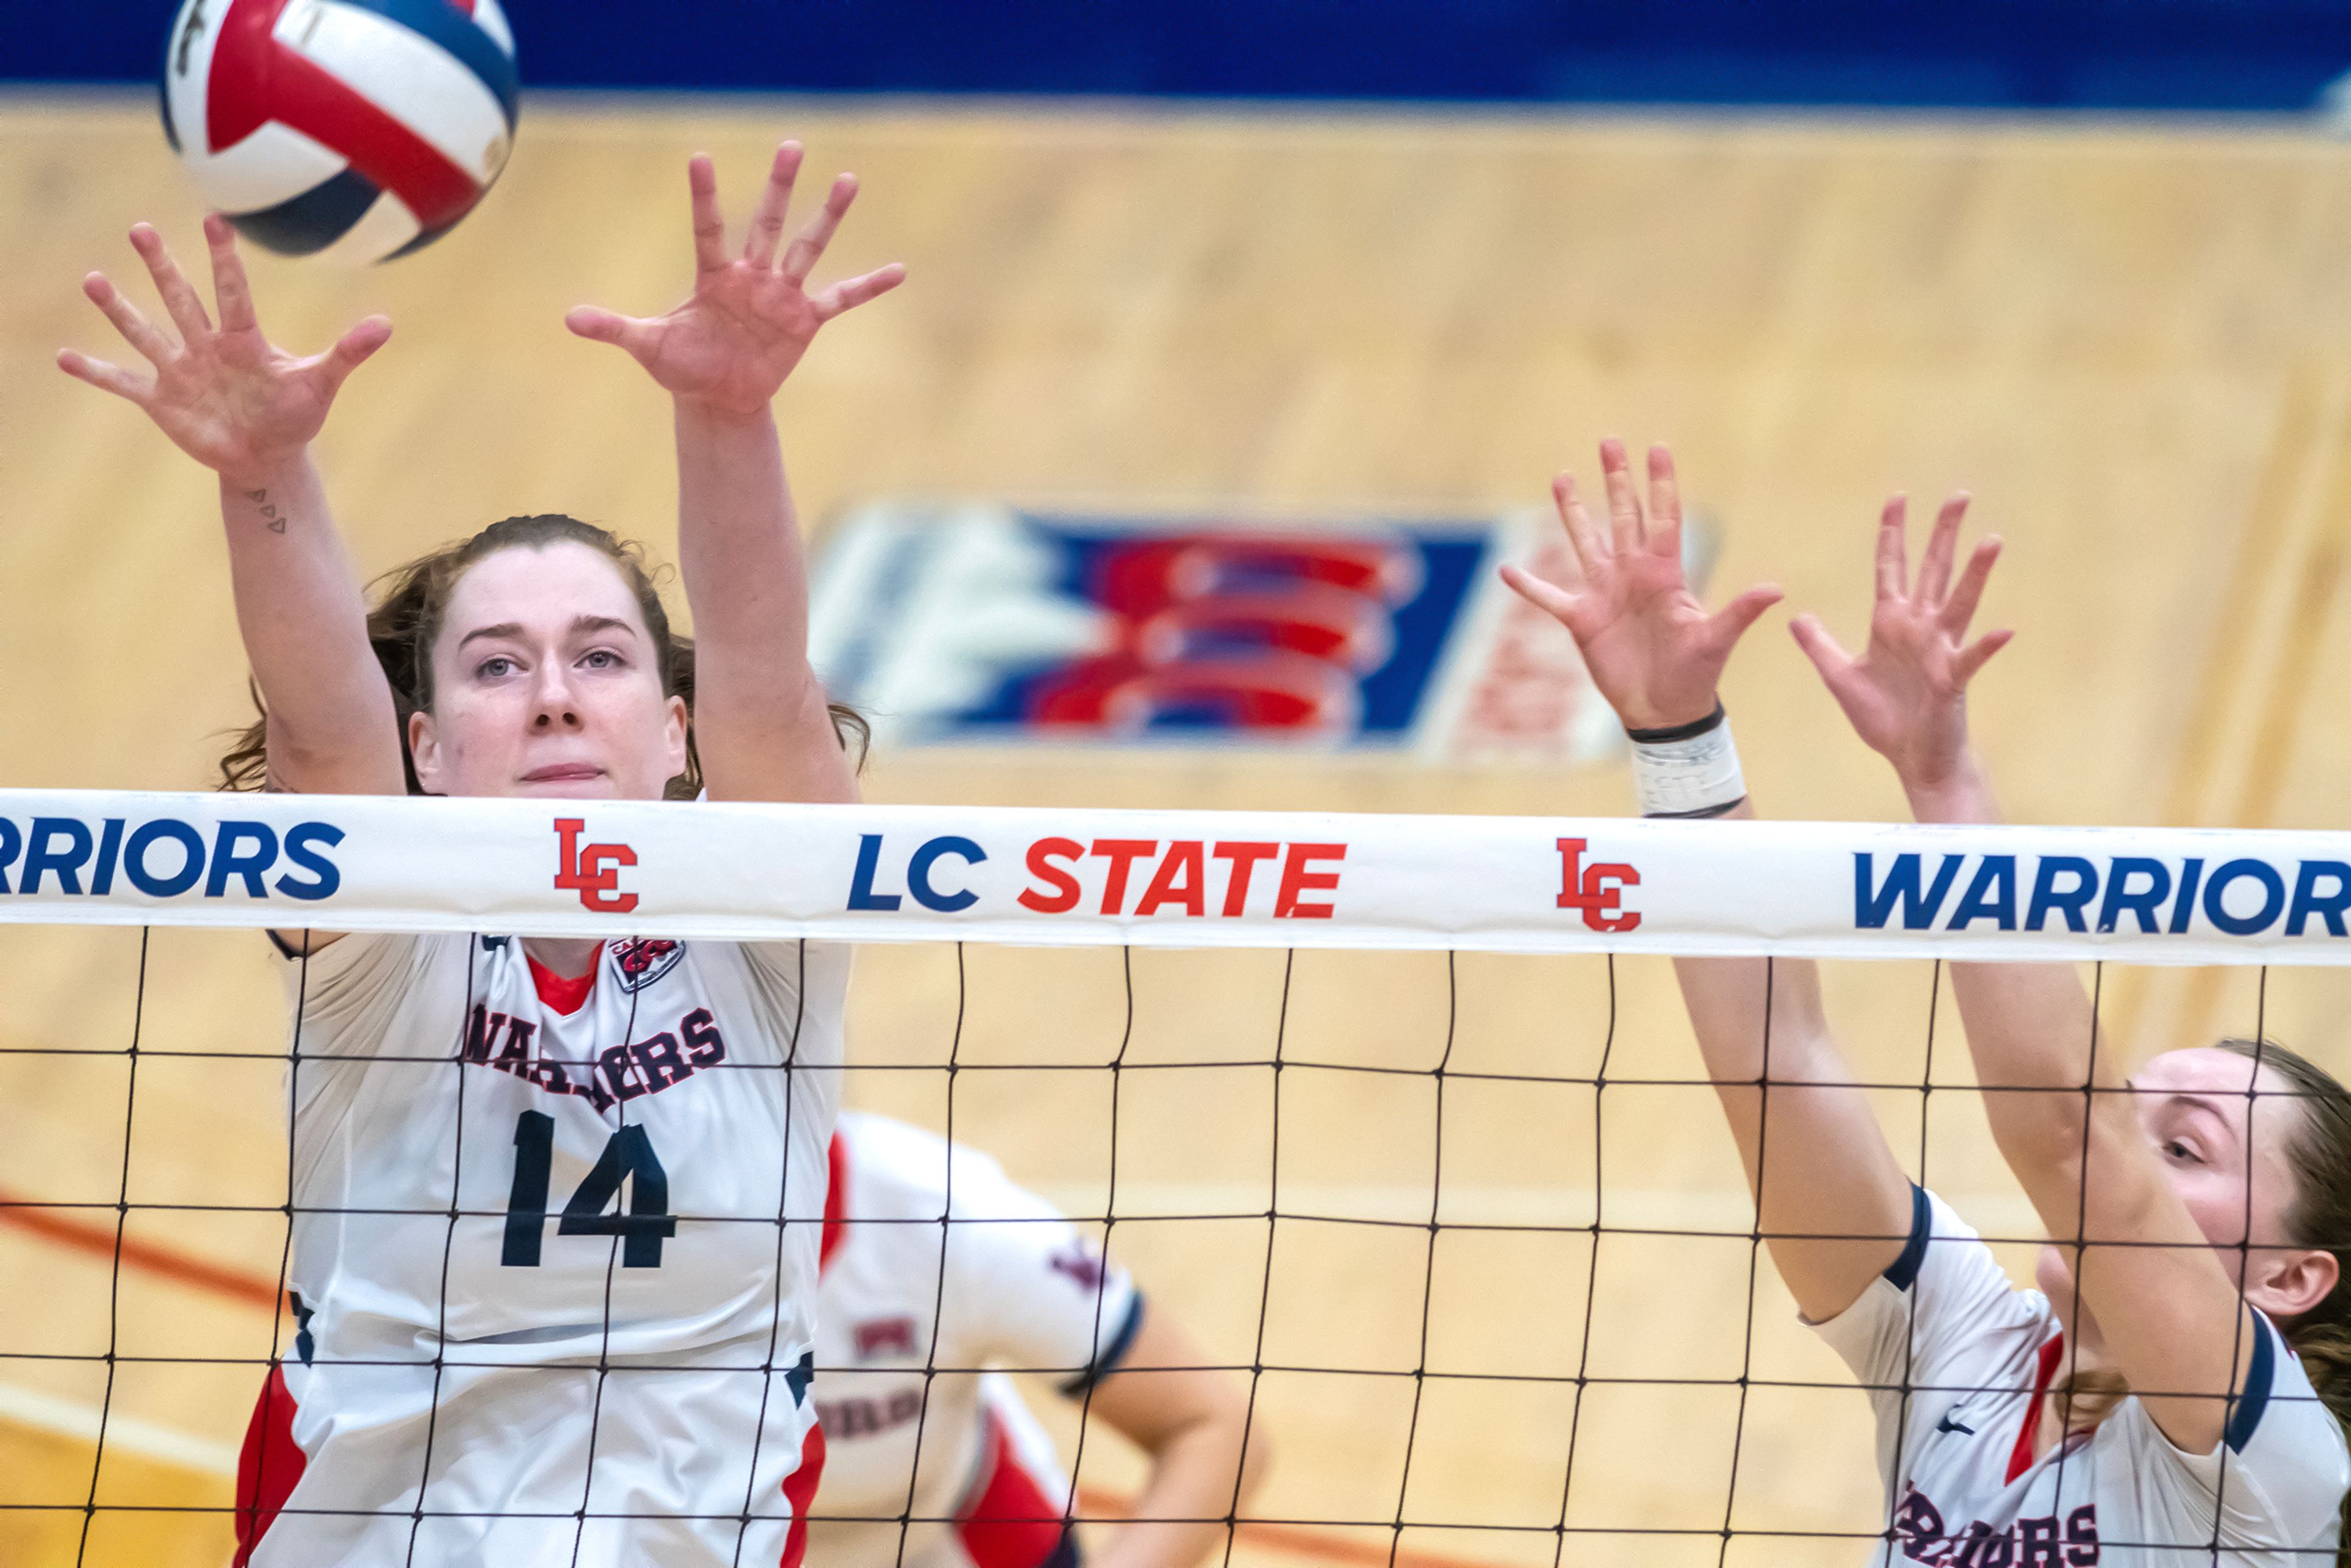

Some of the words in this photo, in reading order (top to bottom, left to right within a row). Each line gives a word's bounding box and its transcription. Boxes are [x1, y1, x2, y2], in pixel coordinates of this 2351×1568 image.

[553, 818, 639, 913] LC
[847, 834, 988, 913] LC
[1017, 836, 1348, 919] STATE
[1556, 838, 1641, 932] LC
[1852, 852, 2351, 937] WARRIOR
[501, 1109, 676, 1268] 14
